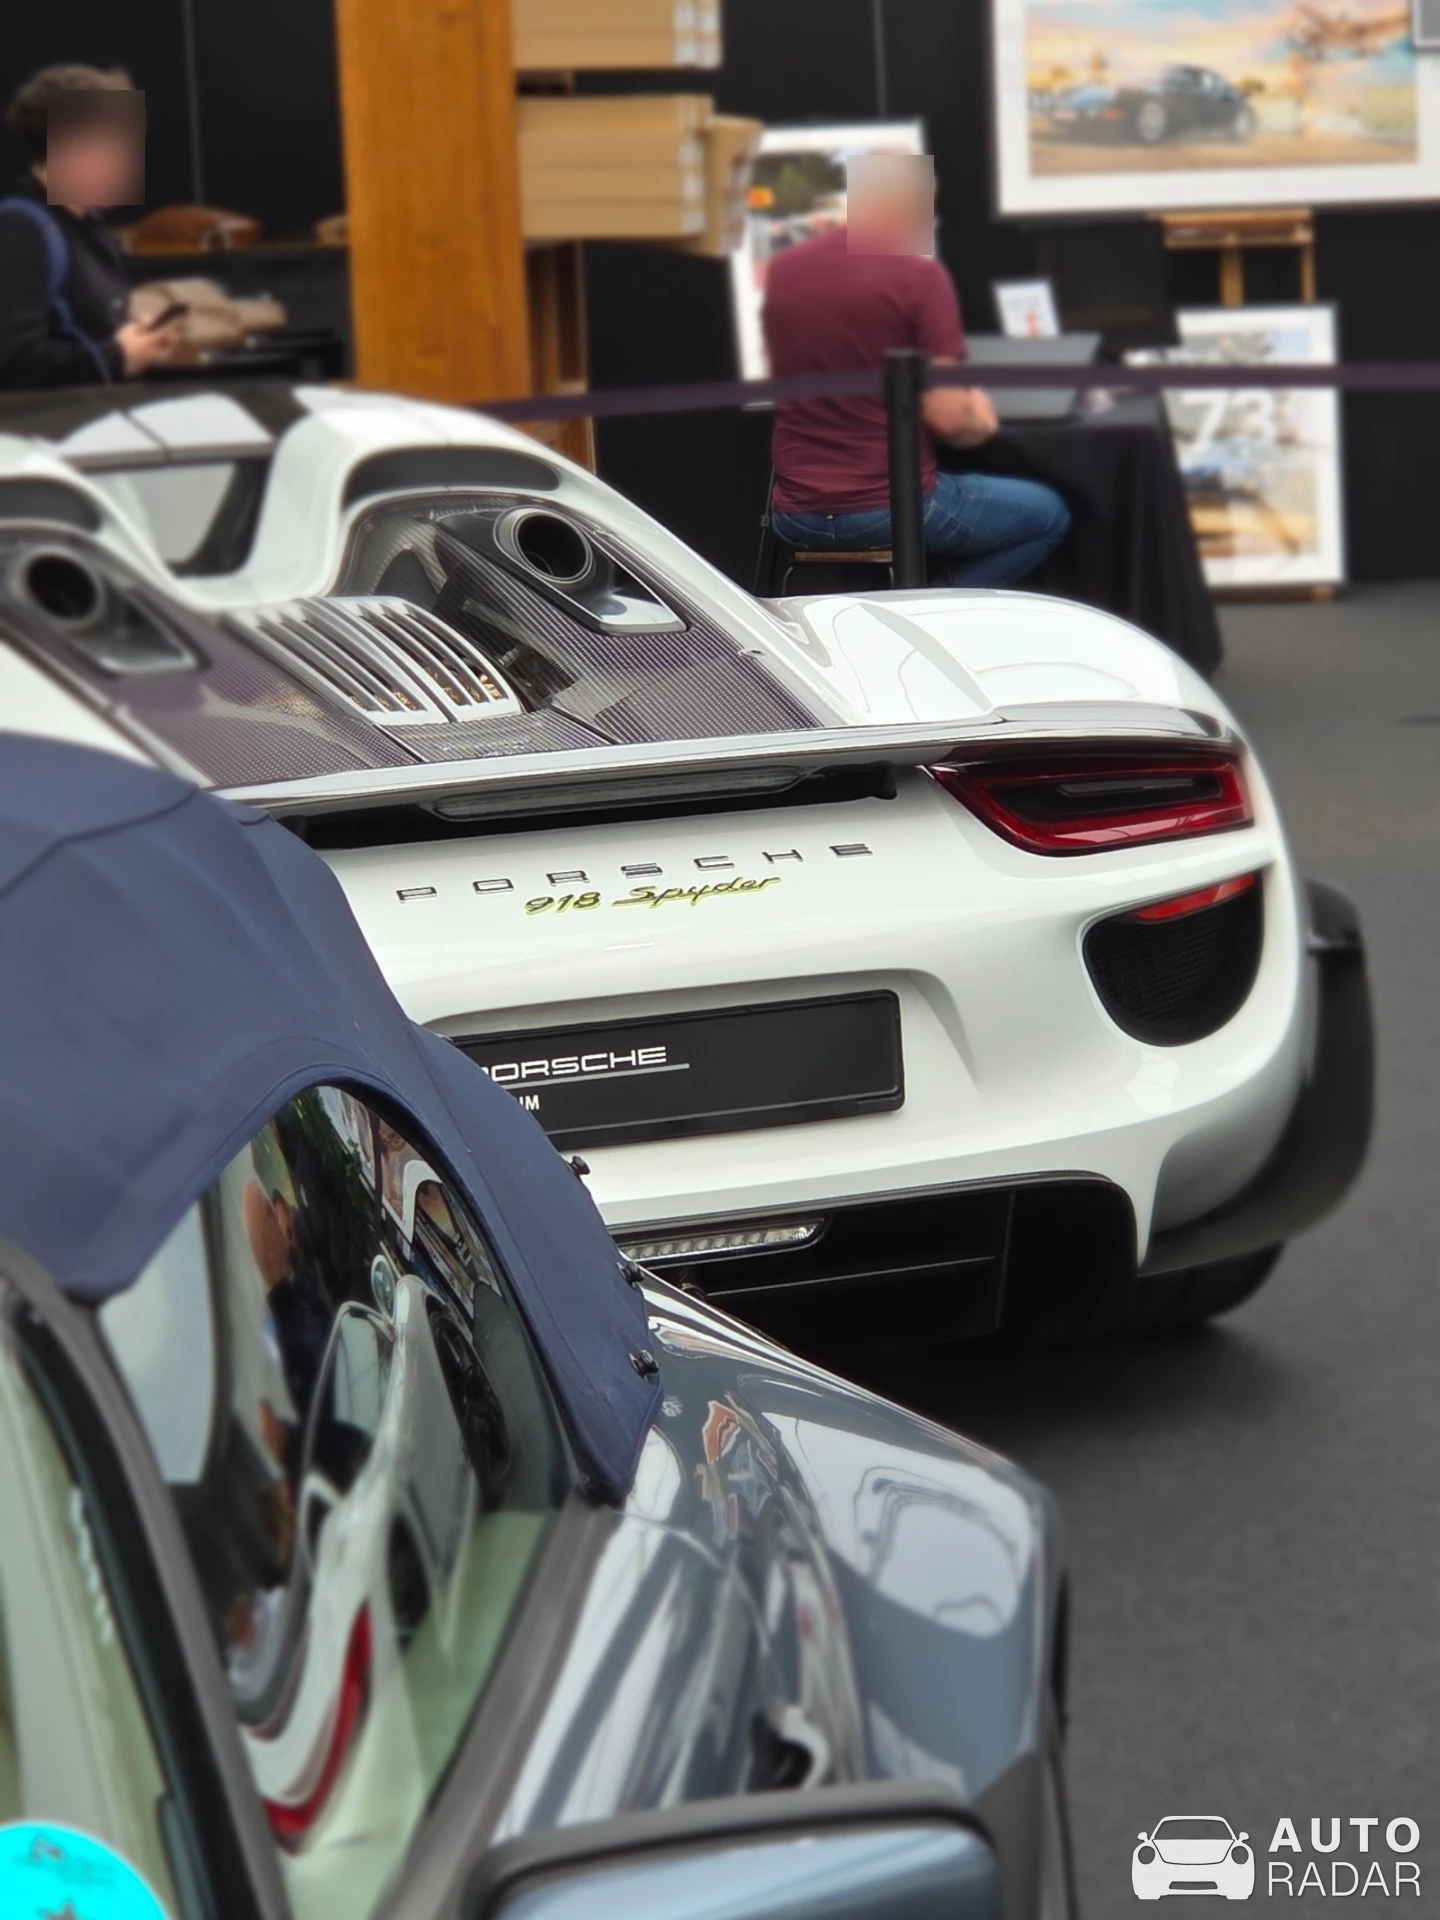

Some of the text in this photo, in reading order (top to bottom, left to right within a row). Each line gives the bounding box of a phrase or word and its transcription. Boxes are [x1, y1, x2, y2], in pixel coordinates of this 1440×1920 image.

[396, 842, 874, 904] PORSCHE
[524, 875, 782, 915] 918 Spyder
